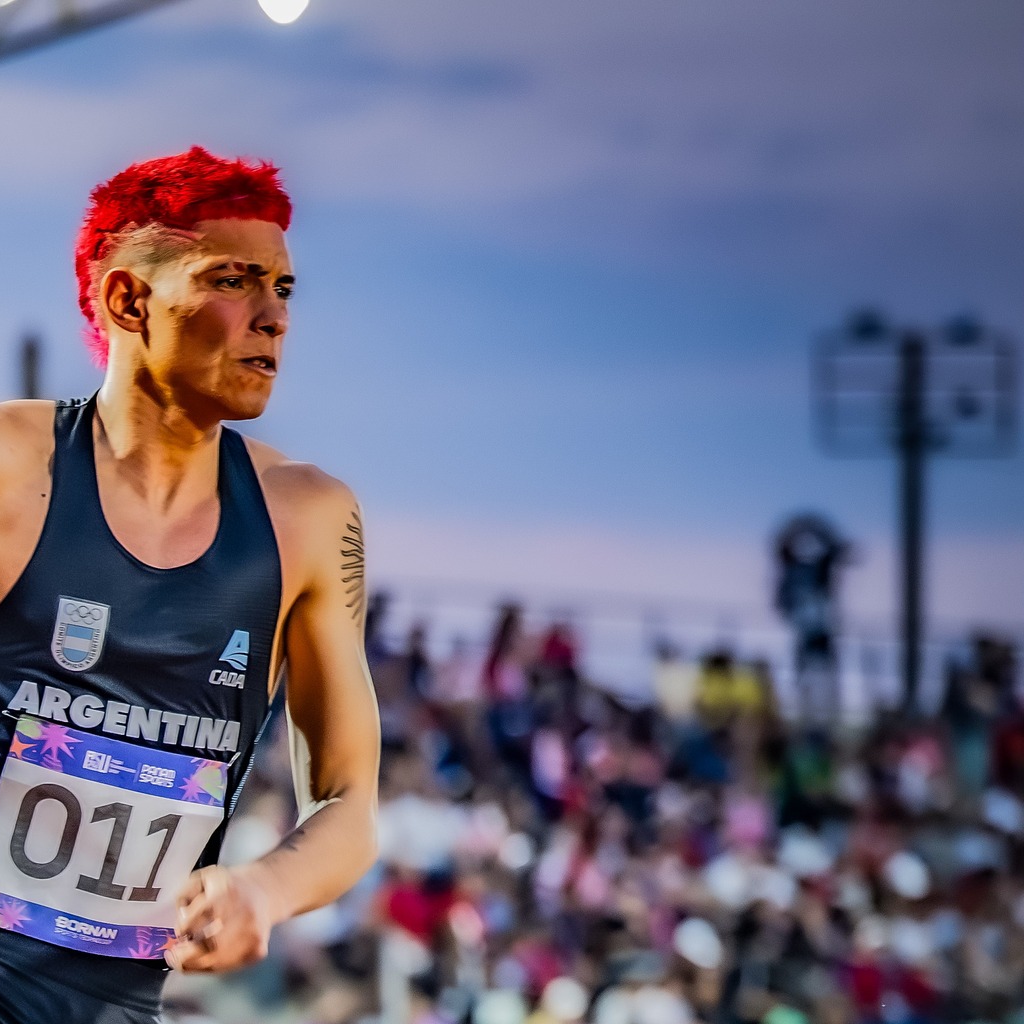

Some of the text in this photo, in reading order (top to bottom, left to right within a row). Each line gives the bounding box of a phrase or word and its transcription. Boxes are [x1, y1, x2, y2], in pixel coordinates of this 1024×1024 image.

[208, 669, 246, 690] CADA
[7, 680, 241, 752] ARGENTINA
[9, 783, 182, 902] 011
[54, 915, 118, 940] BORNAN
